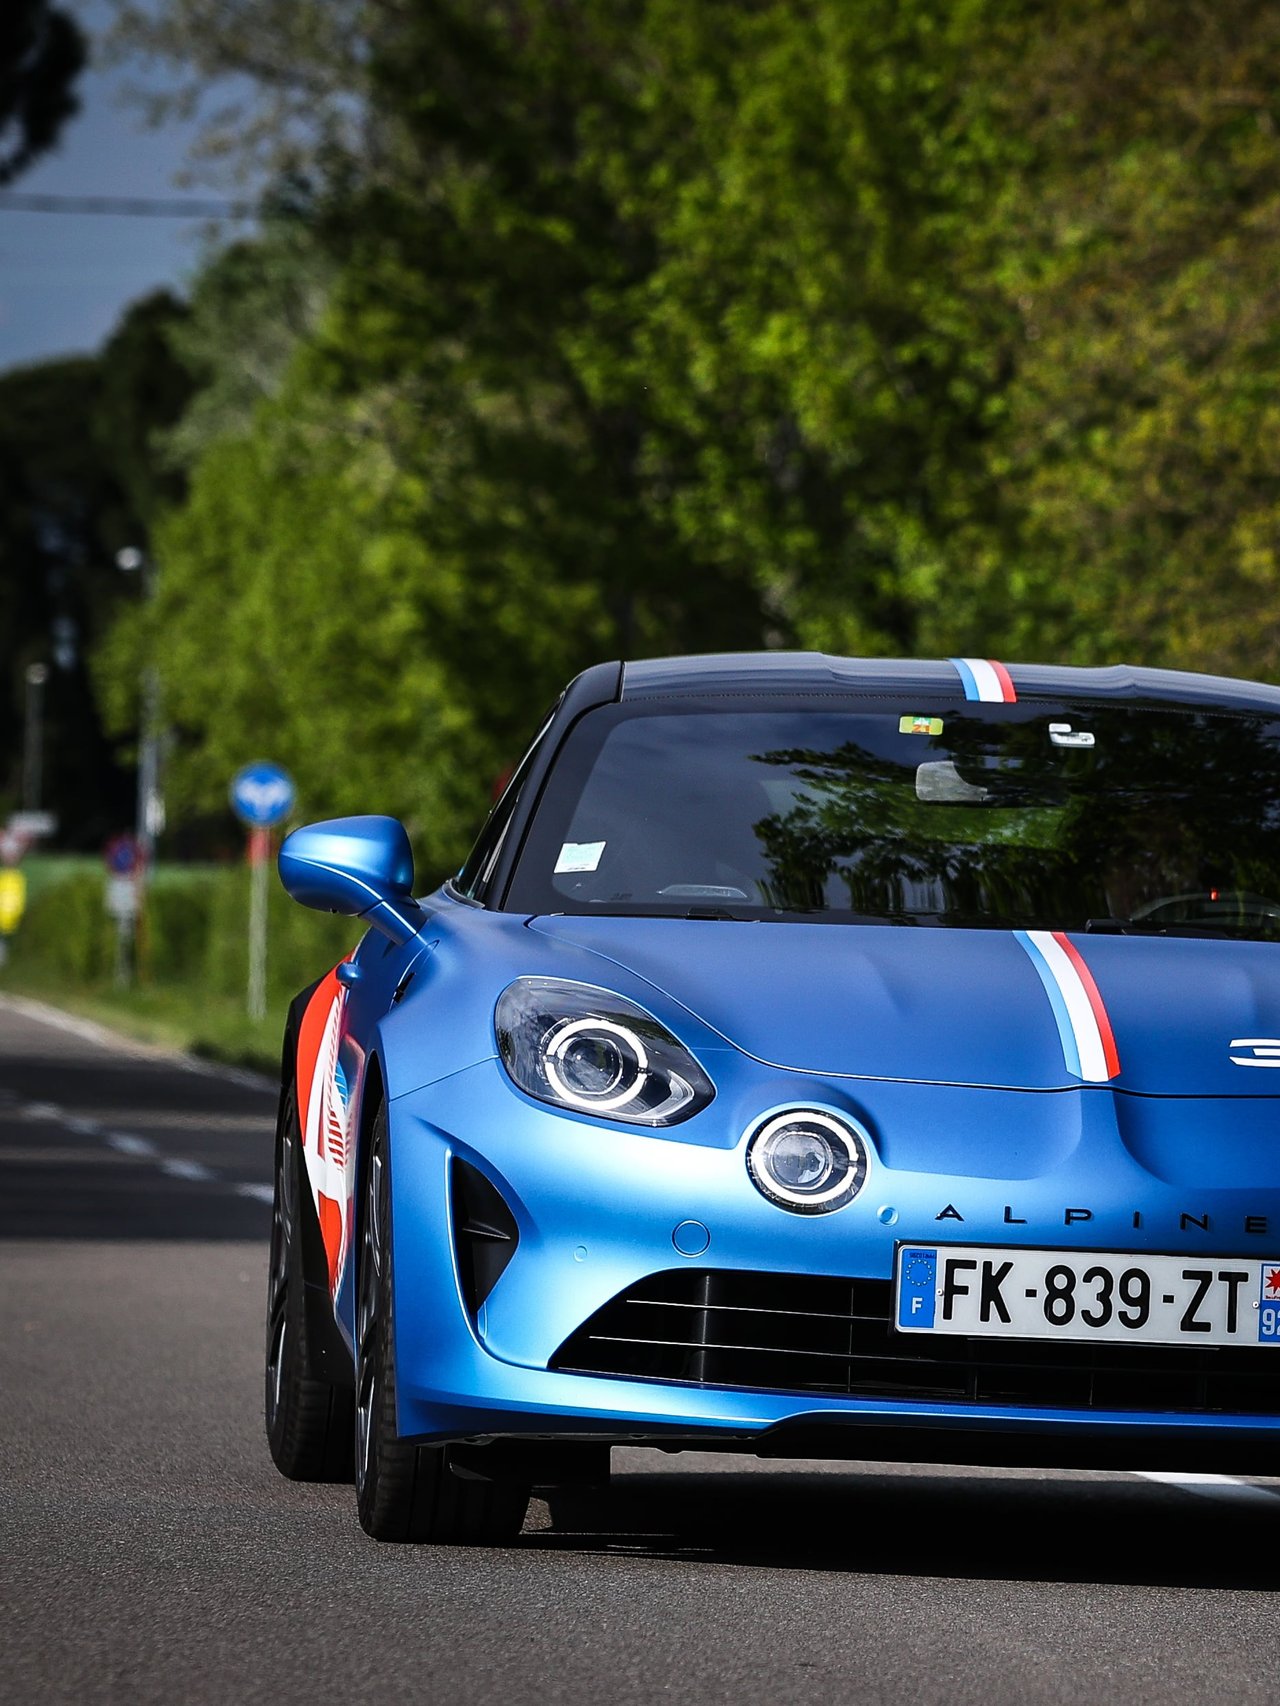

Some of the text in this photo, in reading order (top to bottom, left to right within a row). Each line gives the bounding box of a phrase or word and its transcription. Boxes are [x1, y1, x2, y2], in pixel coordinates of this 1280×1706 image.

[934, 1203, 1268, 1234] ALPINE
[911, 1297, 923, 1314] F
[942, 1258, 1249, 1334] FK-839-ZT
